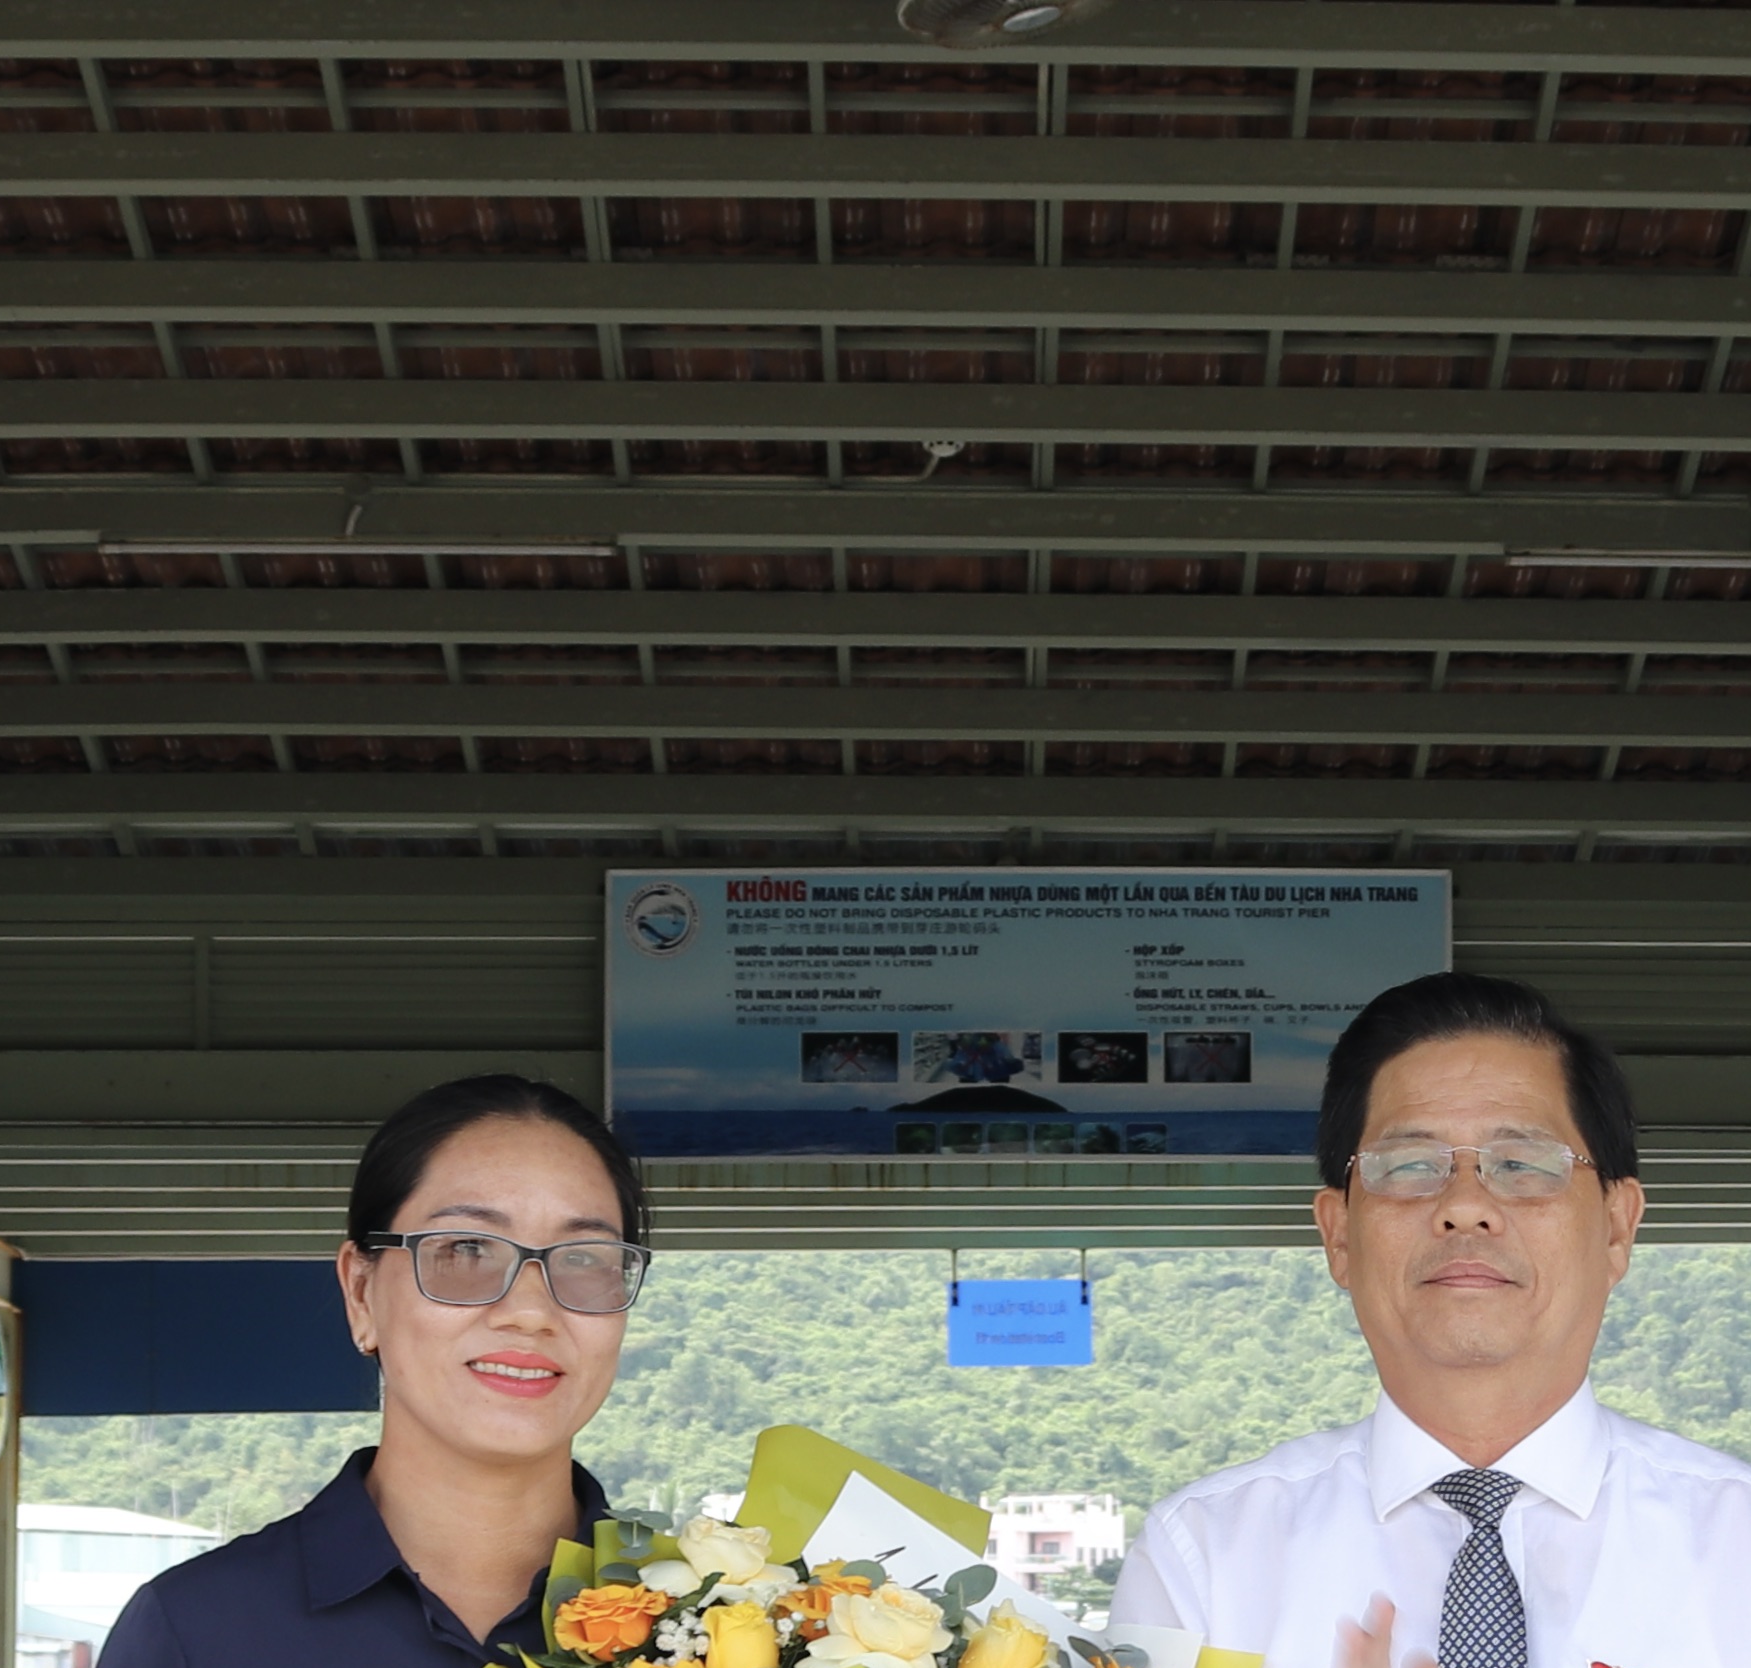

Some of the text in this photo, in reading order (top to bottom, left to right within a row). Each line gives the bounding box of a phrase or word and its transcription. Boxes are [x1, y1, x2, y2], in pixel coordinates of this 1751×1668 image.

[726, 877, 1417, 905] KHÔNG MANG CÁC SẢN PHẨM NHỰA DÙNG MỘT LẦN QUA BẾN TÀU DU LỊCH NHA TRANG
[725, 907, 1330, 919] PLEASE DO NOT BRING DISPOSABLE PLASTIC PRODUCTS TO NHA TRANG TOURIST PIER
[777, 959, 829, 967] BOTTLES
[831, 959, 871, 967] UNDER
[892, 959, 933, 967] LITERS
[1134, 958, 1245, 967] STYROFOAM BOXES
[735, 1003, 953, 1012] PLASTIC BAGS DIFFICULT TO COMPOST
[1135, 1003, 1206, 1011] DISPOSABLE
[1300, 1003, 1341, 1012] BOWLS
